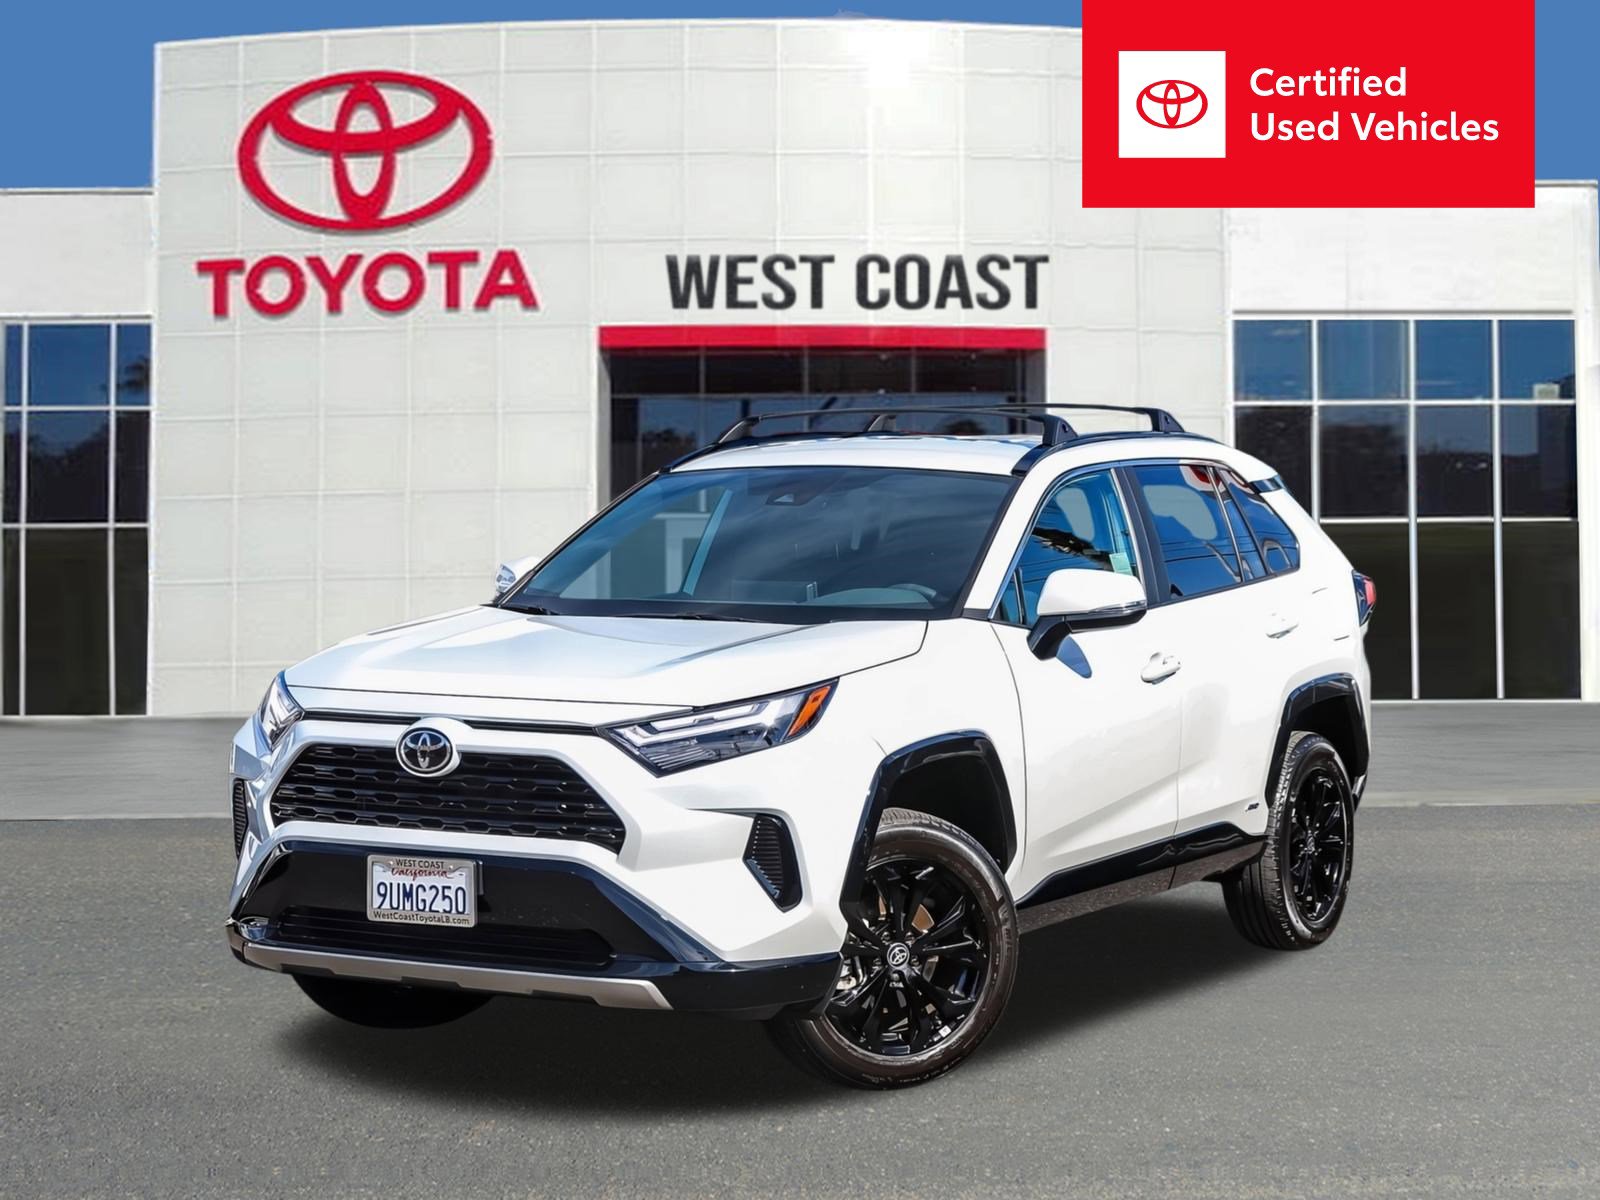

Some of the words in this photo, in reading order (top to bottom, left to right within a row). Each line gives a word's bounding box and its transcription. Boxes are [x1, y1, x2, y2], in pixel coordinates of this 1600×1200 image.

[197, 250, 540, 318] TOYOTA
[665, 254, 835, 309] WEST
[855, 254, 1049, 310] COAST
[395, 859, 417, 868] WEST
[418, 860, 444, 869] COAST
[376, 881, 466, 914] 9UMG250
[373, 911, 470, 925] WestCoastToyotaLB.com
